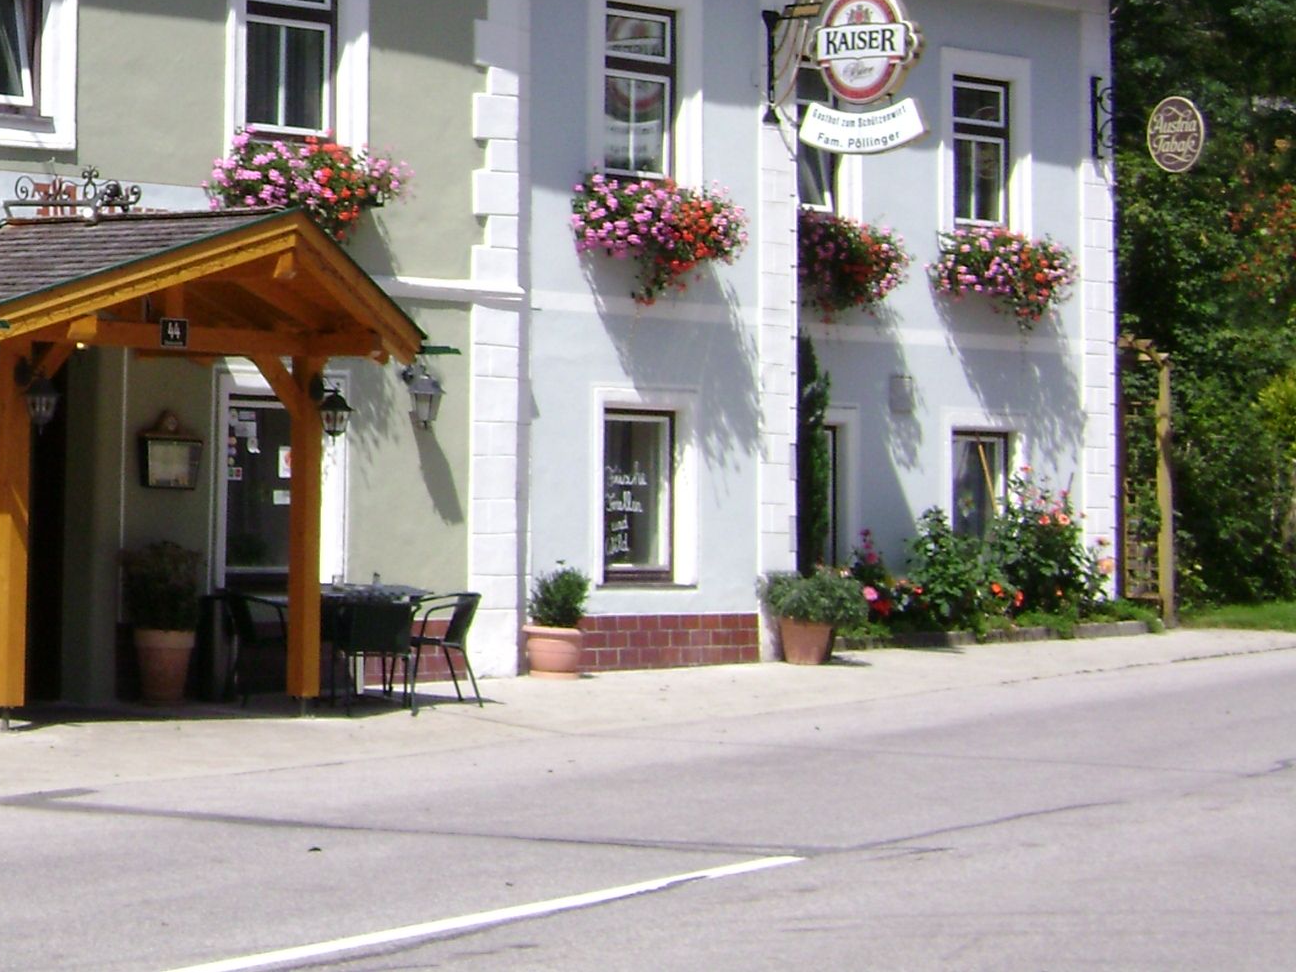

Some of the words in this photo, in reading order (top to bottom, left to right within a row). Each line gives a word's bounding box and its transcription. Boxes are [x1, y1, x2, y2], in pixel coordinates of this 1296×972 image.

[825, 28, 897, 56] KAISER
[841, 118, 856, 128] zum
[817, 132, 844, 148] Fam.
[848, 131, 901, 149] Pöllinger
[167, 321, 181, 339] 44
